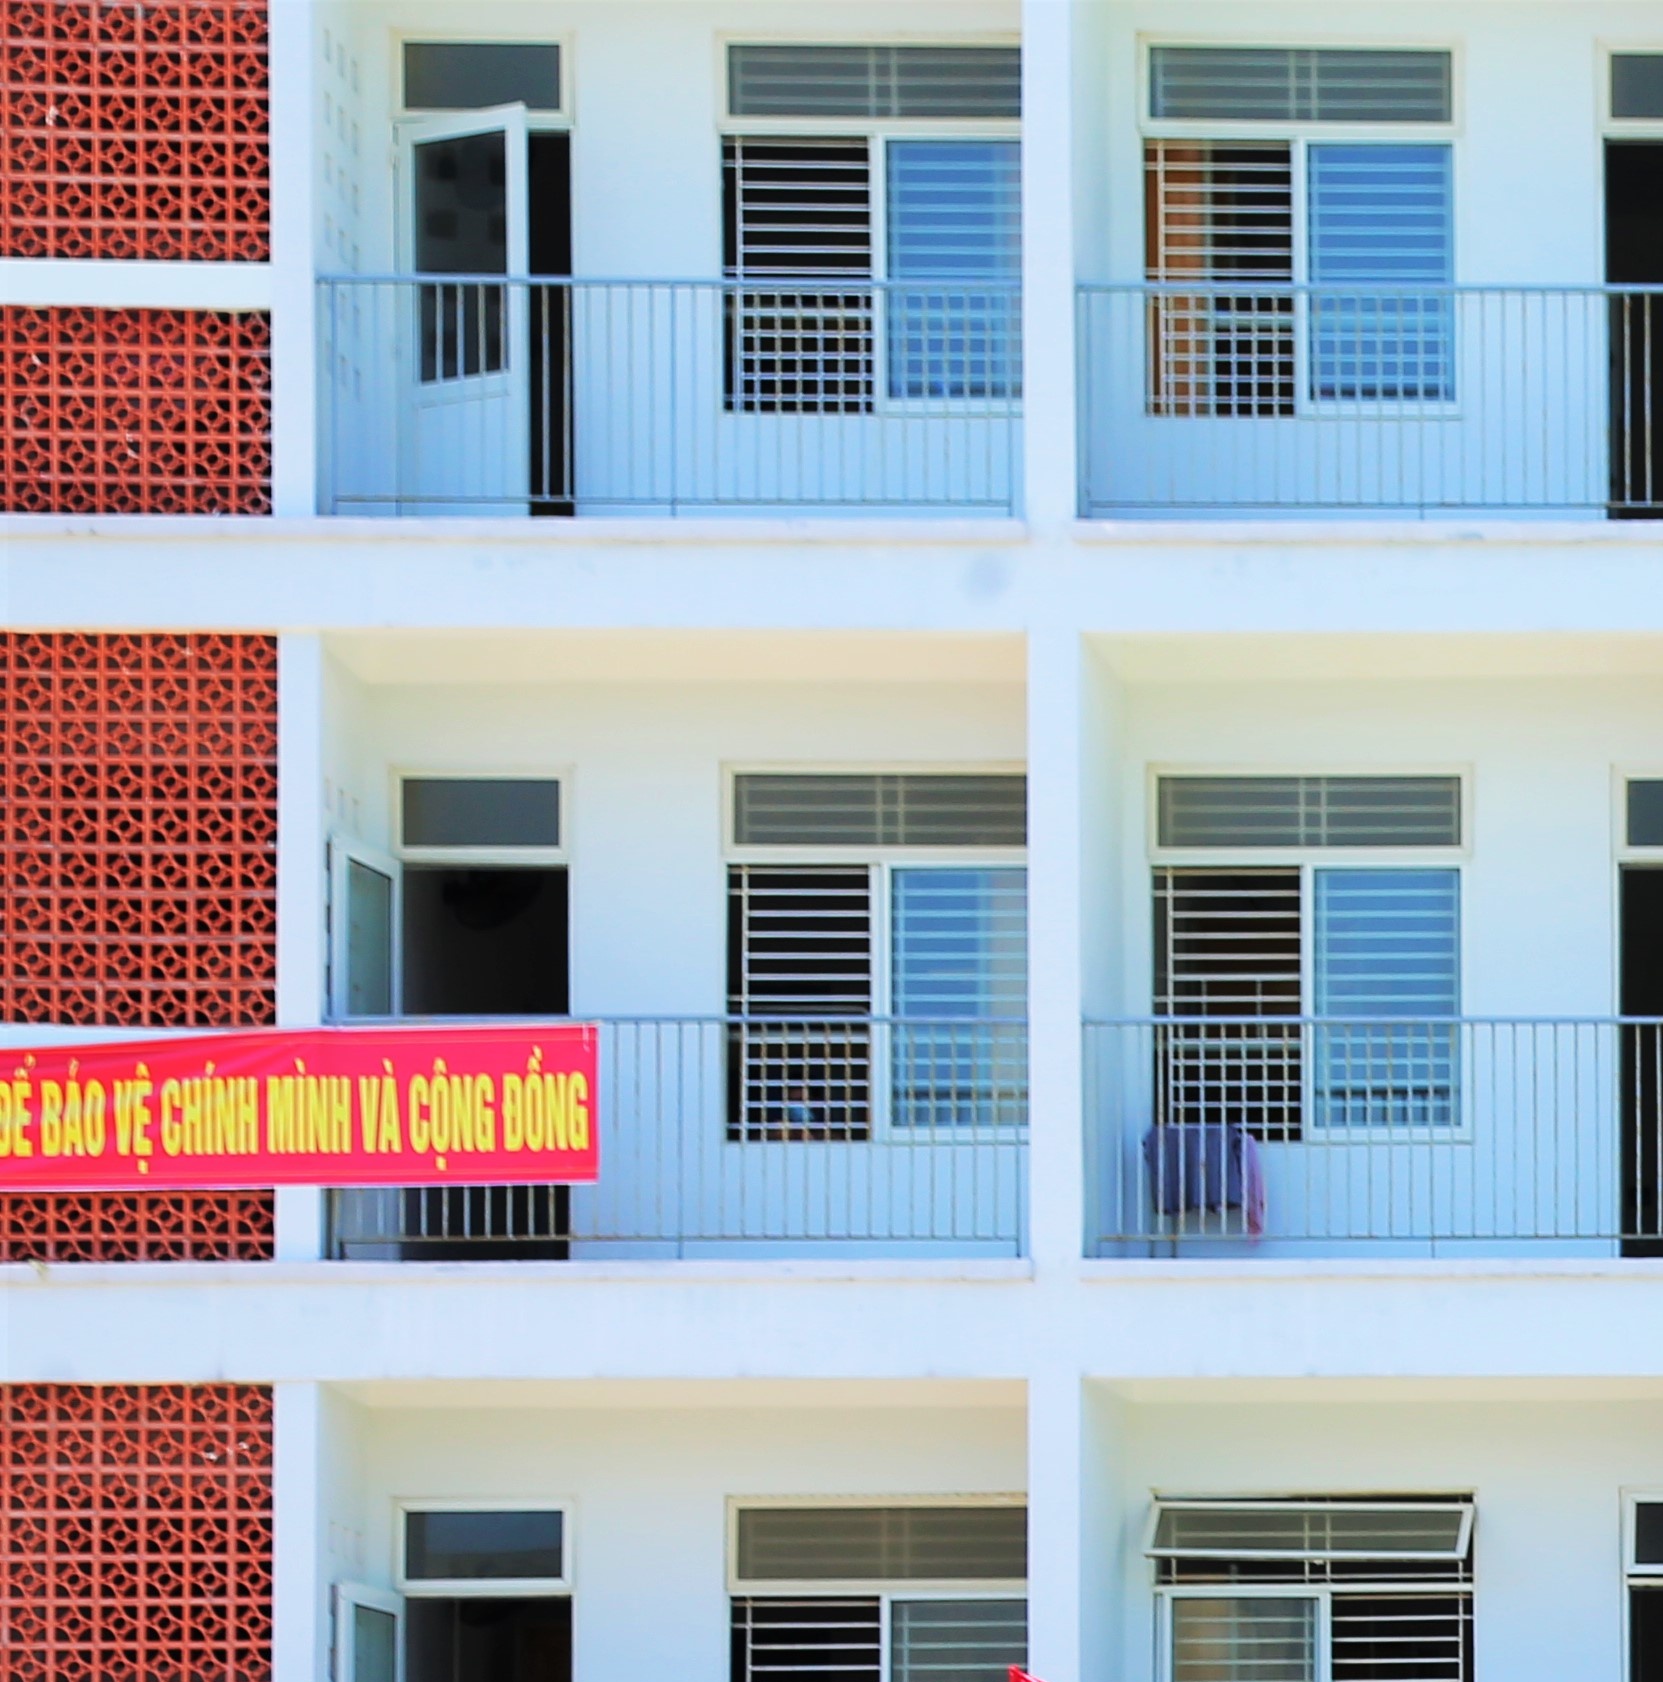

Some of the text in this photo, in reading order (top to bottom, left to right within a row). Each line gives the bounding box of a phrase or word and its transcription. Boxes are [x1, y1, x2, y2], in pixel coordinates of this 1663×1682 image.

[41, 1059, 107, 1157] BẢO
[113, 1062, 153, 1175] VỆ
[161, 1062, 259, 1157] CHÍNH
[266, 1058, 352, 1154] MÌNH
[358, 1058, 402, 1154] VÀ
[408, 1058, 496, 1172] CỘNG
[501, 1045, 589, 1152] ĐỒNG
